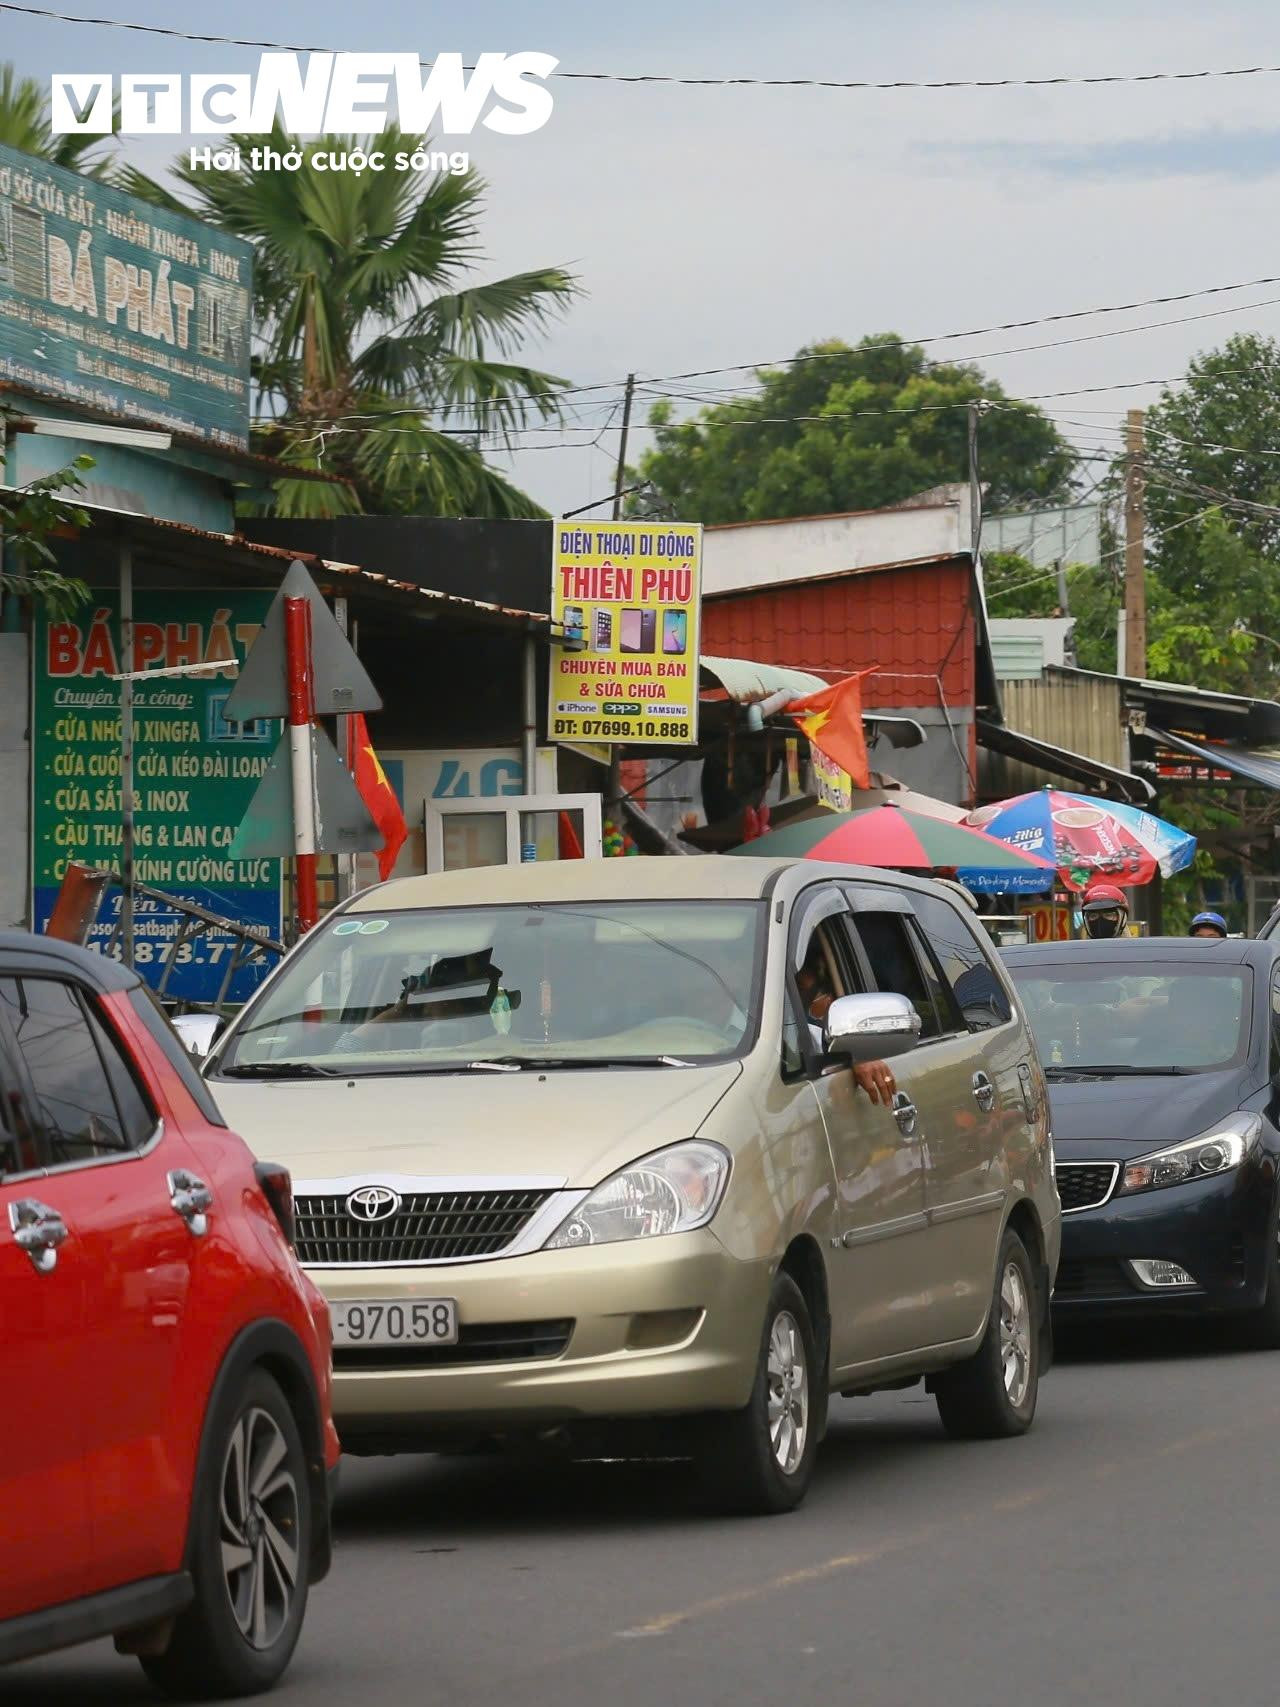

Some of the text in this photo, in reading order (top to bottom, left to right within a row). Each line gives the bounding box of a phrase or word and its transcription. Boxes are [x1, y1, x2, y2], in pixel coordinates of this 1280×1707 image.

[153, 226, 199, 268] XINGFA
[210, 248, 240, 283] INOX
[48, 229, 98, 318] BÁ
[104, 259, 194, 349] PHÁT
[560, 528, 694, 562] ĐIỆN THOẠI DI ĐỘNG
[560, 560, 693, 604] THIÊN PHÚ
[48, 608, 119, 679] BÁ
[560, 658, 687, 677] CHUYÊN MUA BÁN
[54, 687, 115, 709] Chuyên
[119, 690, 146, 705] ia
[579, 678, 666, 698] & SỬA CHỮA
[567, 703, 597, 713] iPhone
[647, 705, 687, 715] SAMSUNG
[55, 713, 87, 741] CỬA
[144, 721, 200, 742] XINGFA
[554, 719, 689, 738] ĐT: 07699.10.888
[54, 748, 85, 776] CỬA
[89, 748, 123, 776] CUỐ
[137, 748, 167, 777] CỬA
[172, 749, 199, 777] KÉO
[203, 750, 228, 777] ĐÀI
[55, 780, 91, 811] CỬA
[96, 779, 123, 811] SẮT
[148, 791, 189, 812] INOX
[55, 817, 88, 846] CẦU
[93, 825, 153, 846] THANG
[158, 827, 169, 846] &
[174, 826, 207, 847] LAN
[134, 854, 171, 881] KÍNH
[176, 854, 234, 882] CƯỜNG
[239, 861, 270, 888] LỰC
